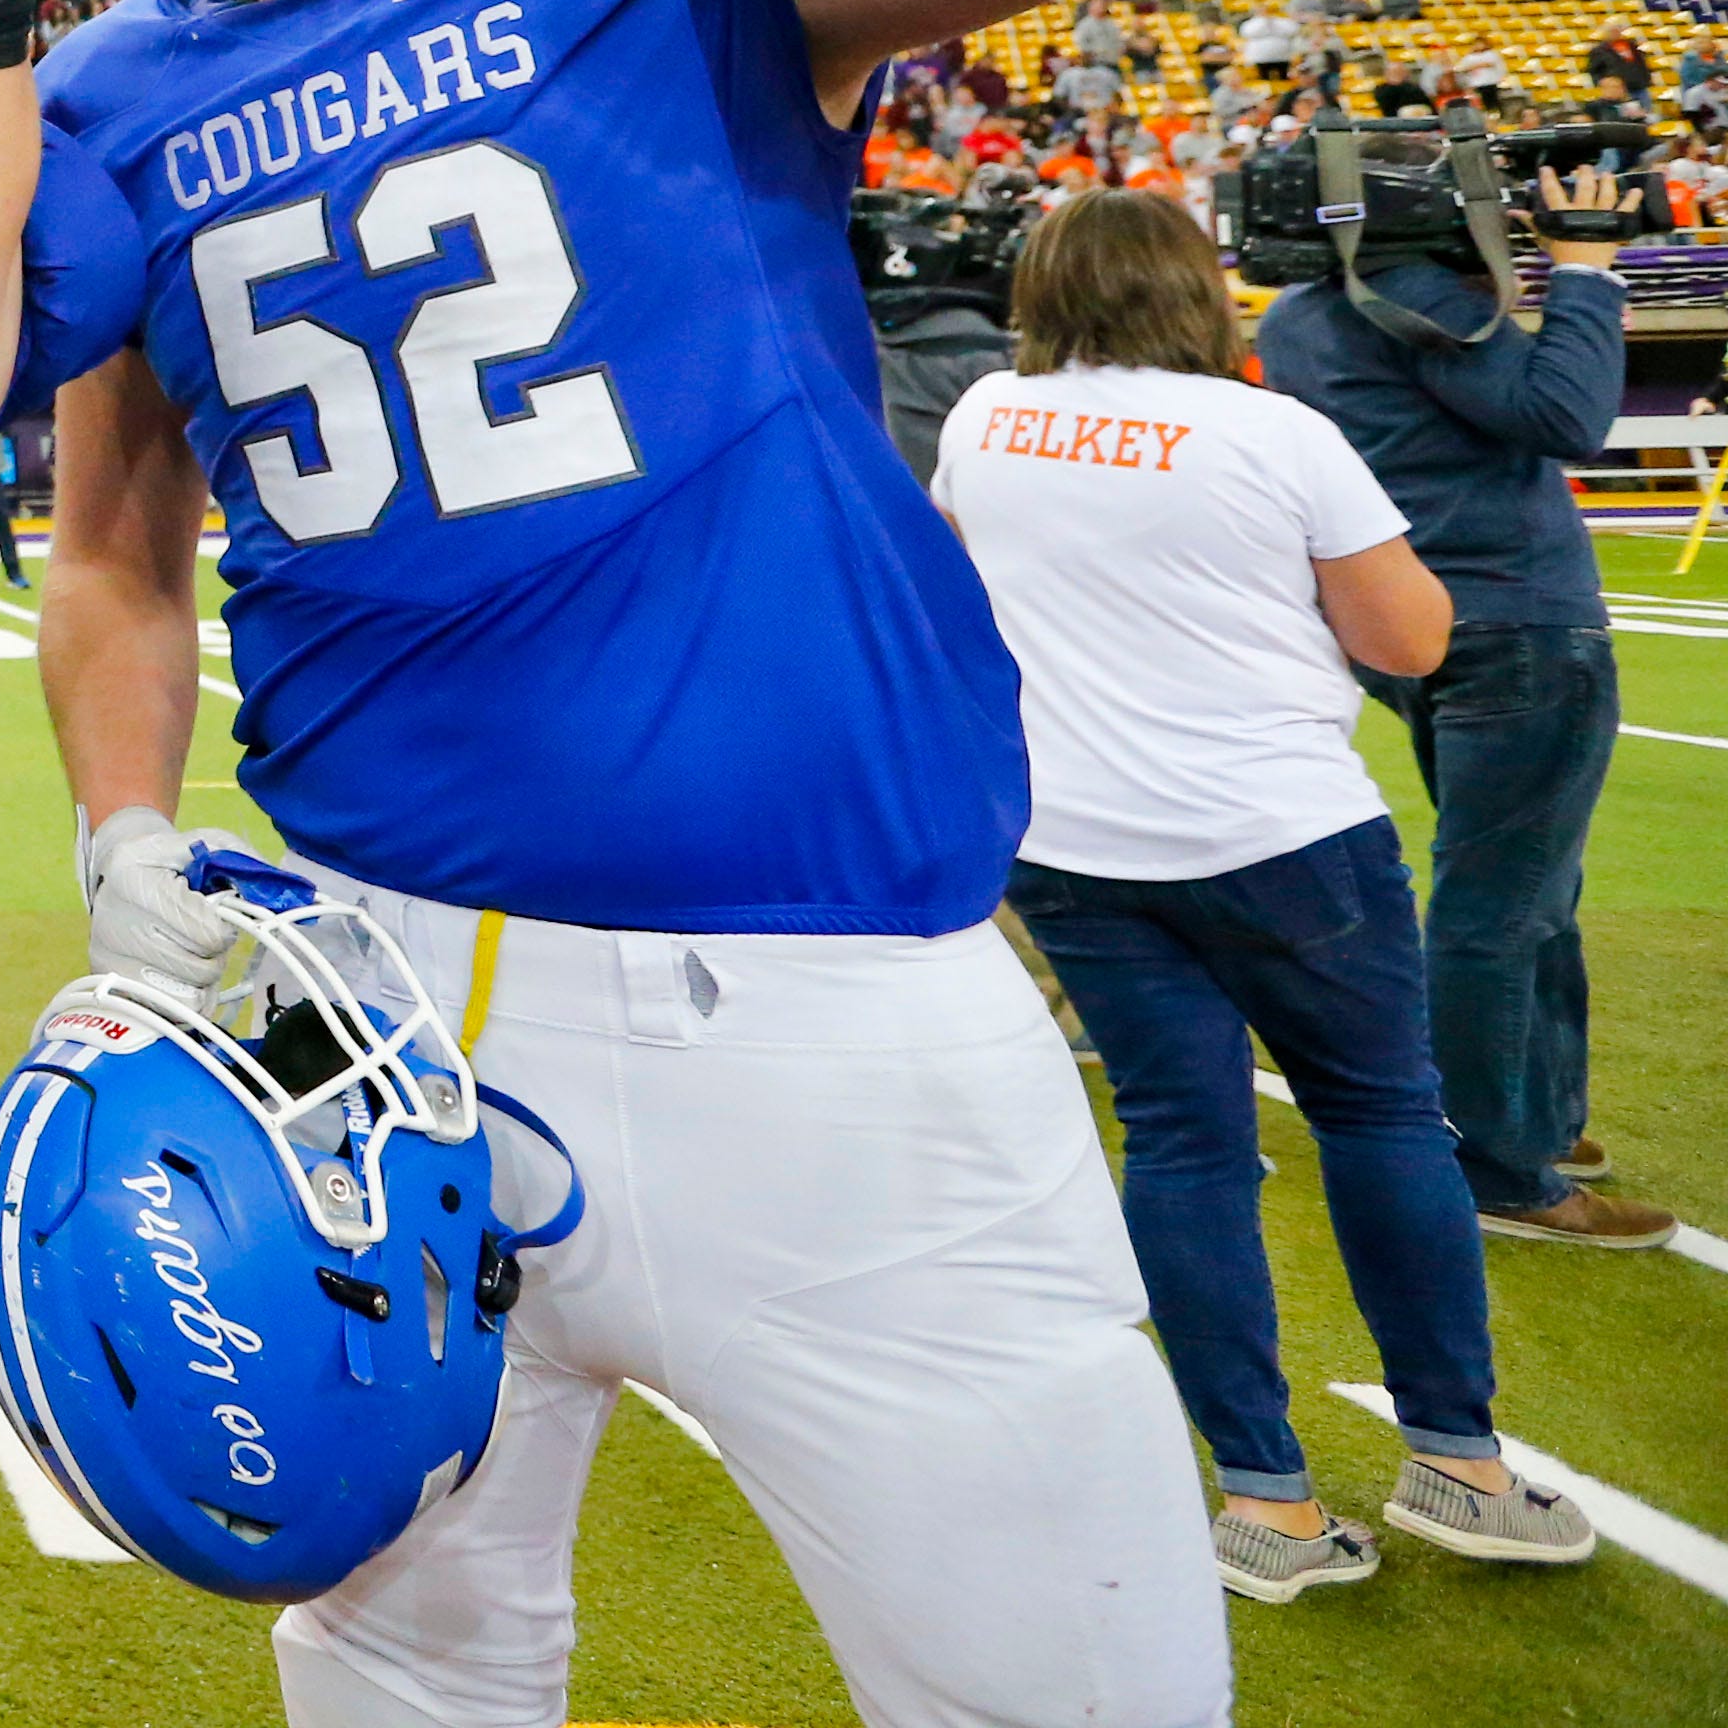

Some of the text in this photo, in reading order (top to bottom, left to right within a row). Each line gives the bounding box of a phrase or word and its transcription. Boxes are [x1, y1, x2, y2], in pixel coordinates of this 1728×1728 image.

[163, 0, 540, 212] COUGARS
[190, 138, 645, 547] 52
[979, 406, 1191, 473] FELKEY
[47, 1013, 131, 1040] Riddell
